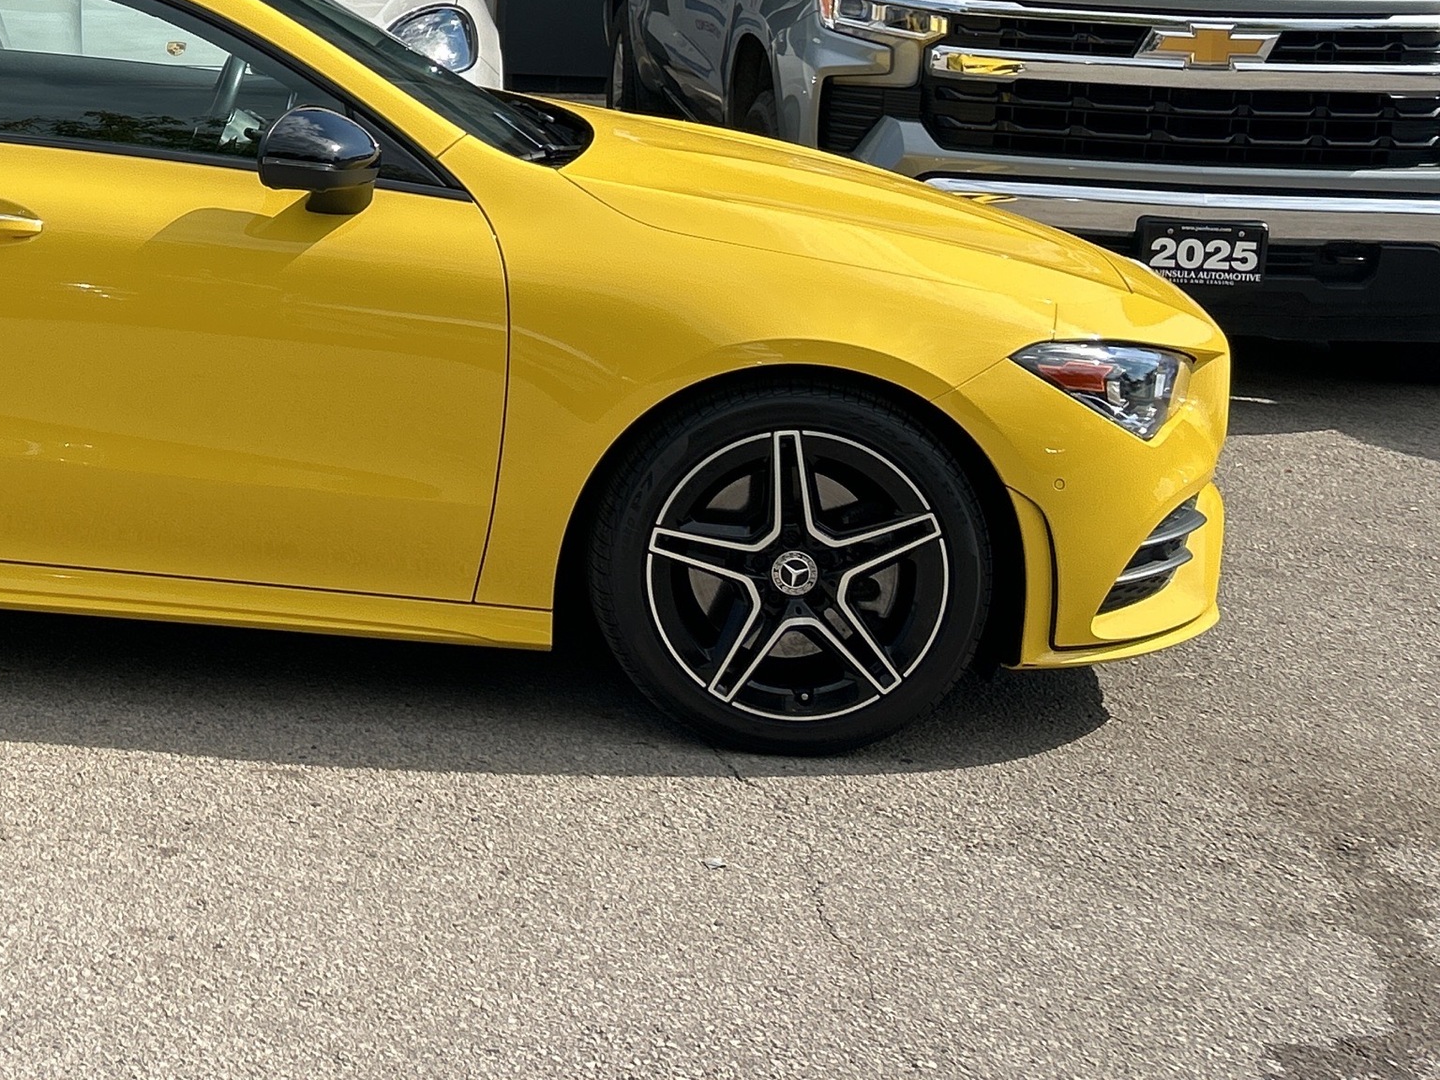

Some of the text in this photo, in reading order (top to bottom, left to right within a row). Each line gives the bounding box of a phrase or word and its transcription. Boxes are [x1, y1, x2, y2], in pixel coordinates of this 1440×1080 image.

[1149, 237, 1259, 272] 2025
[1155, 269, 1262, 282] NINSULA AUTOMOTIVE
